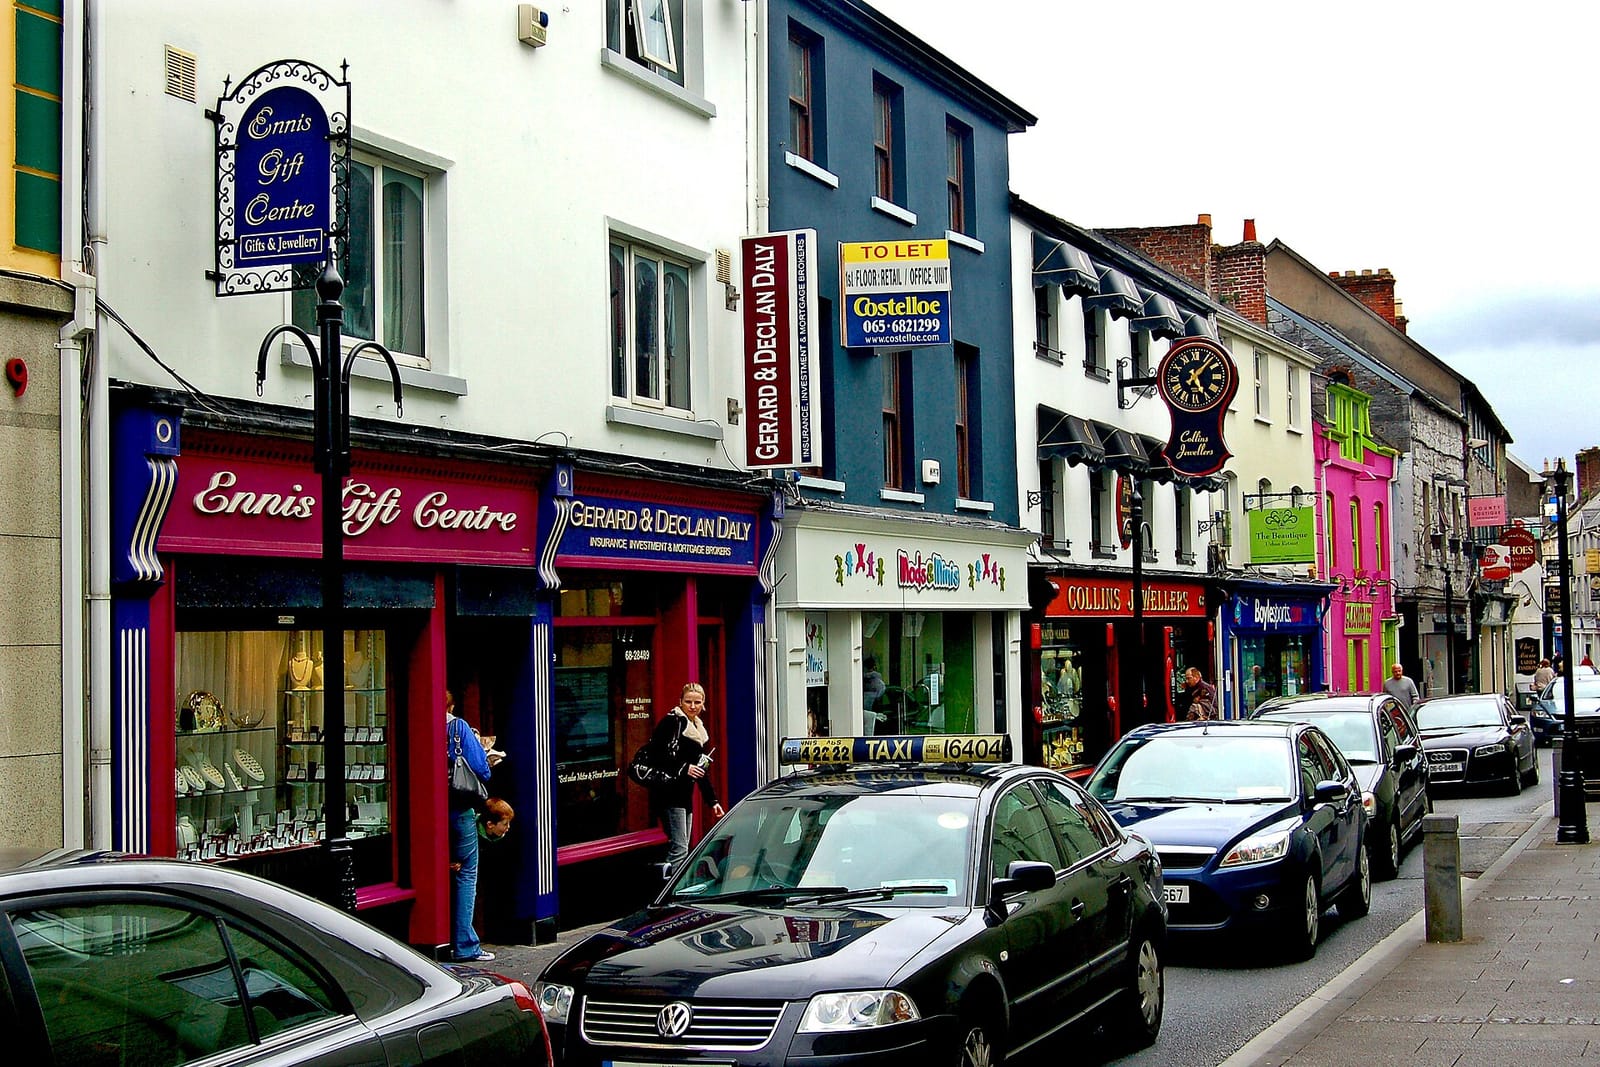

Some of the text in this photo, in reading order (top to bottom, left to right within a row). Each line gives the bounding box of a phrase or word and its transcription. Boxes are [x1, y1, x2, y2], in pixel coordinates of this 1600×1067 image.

[248, 106, 312, 140] Ennis
[258, 148, 304, 186] Gift
[245, 192, 314, 226] Centre
[245, 234, 318, 254] Gifts & Jewellery
[861, 244, 932, 258] TO LET
[797, 238, 806, 282] BROKERS
[910, 266, 932, 285] OFFICE
[934, 266, 948, 284] UNIT
[798, 284, 807, 336] MORTGAGE
[854, 296, 940, 317] Costelloe
[865, 333, 940, 344] www.costelloe.com
[752, 244, 780, 460] GERARD & DECLAN DALY
[800, 346, 808, 401] INVESTMENT
[1180, 430, 1208, 443] Collins
[1176, 444, 1214, 460] Jewellers
[194, 471, 316, 518] Ennis
[412, 491, 518, 532] Centre
[570, 500, 752, 542] GERARD & DECLAN DALY
[1256, 532, 1308, 540] The Beautique
[629, 538, 667, 552] INVESTMENT
[673, 542, 705, 556] MORTGAGE
[705, 544, 732, 557] BROKERS
[1068, 585, 1120, 612] COLLINS
[1127, 586, 1189, 612] JWELLERS
[865, 739, 912, 760] TAXI
[943, 739, 1002, 760] 16404
